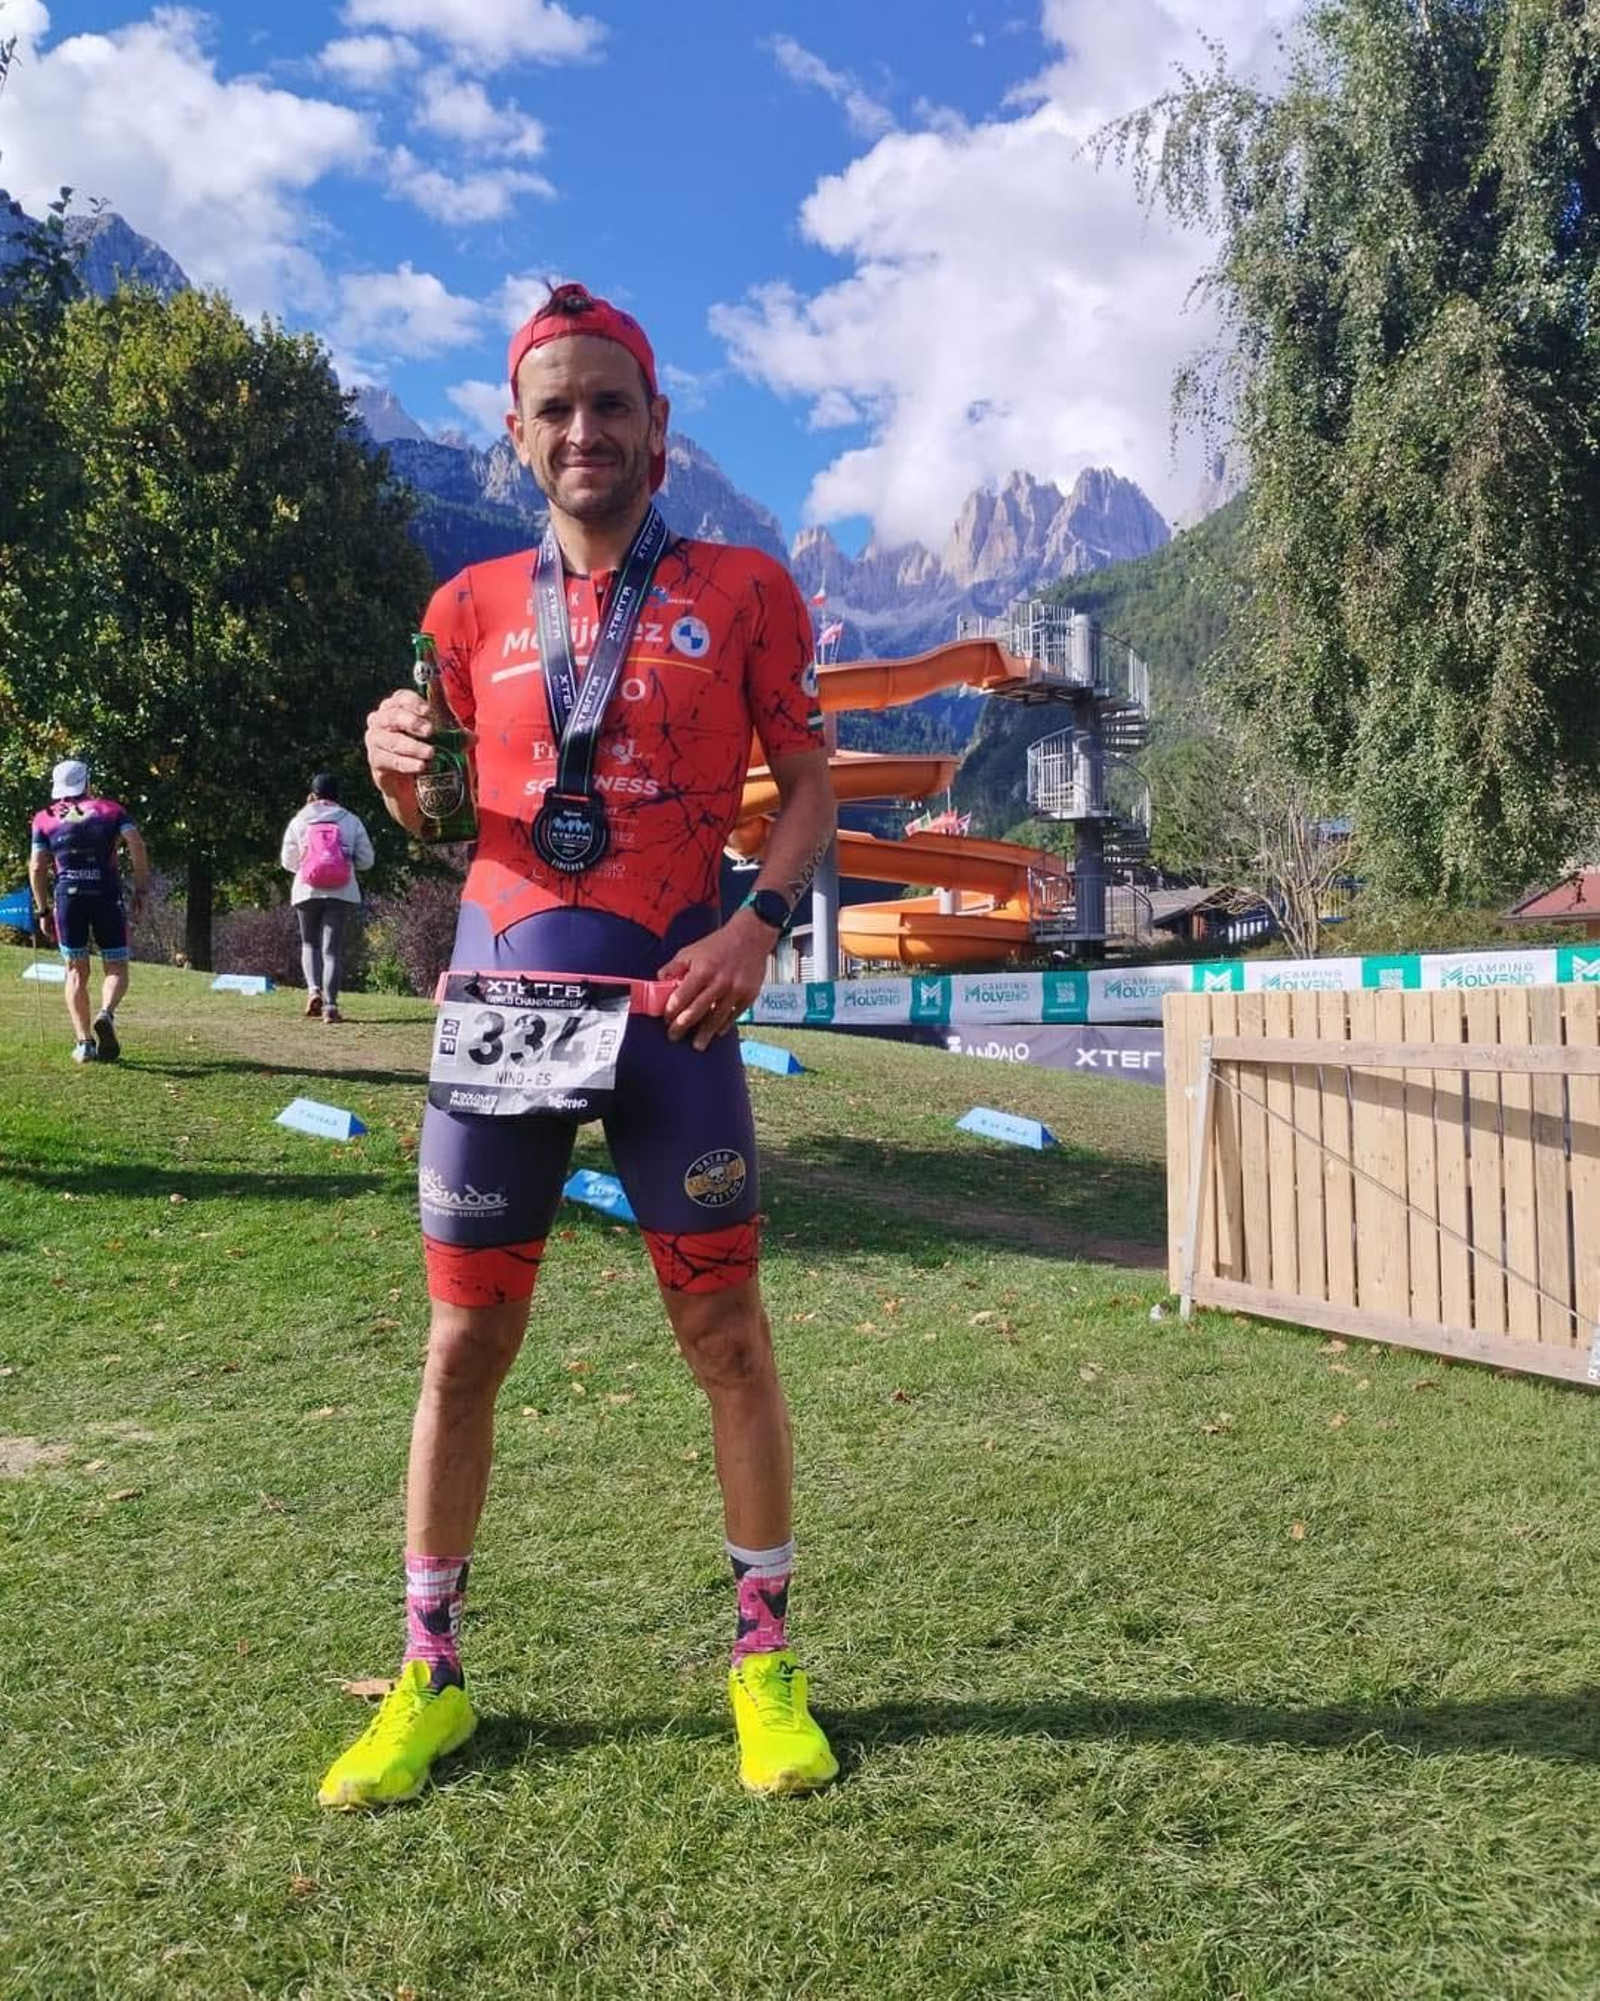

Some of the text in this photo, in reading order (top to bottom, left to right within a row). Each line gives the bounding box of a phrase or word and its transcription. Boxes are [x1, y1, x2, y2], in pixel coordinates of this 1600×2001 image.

[606, 586, 632, 640] XTERRA
[573, 675, 601, 733] XTERRA
[1283, 969, 1343, 979] CAMPING
[1441, 964, 1536, 988] MOLVENO
[1465, 961, 1534, 974] CAMPING
[486, 980, 584, 998] XTERRA
[857, 987, 900, 995] CAMPING
[964, 984, 1030, 1003] MOLVENO
[981, 983, 1029, 991] CAMPING
[515, 997, 581, 1008] CHAMPIONSHIP
[843, 989, 901, 1008] MOLVENO
[468, 1011, 587, 1068] 334
[1074, 1048, 1163, 1069] XTER
